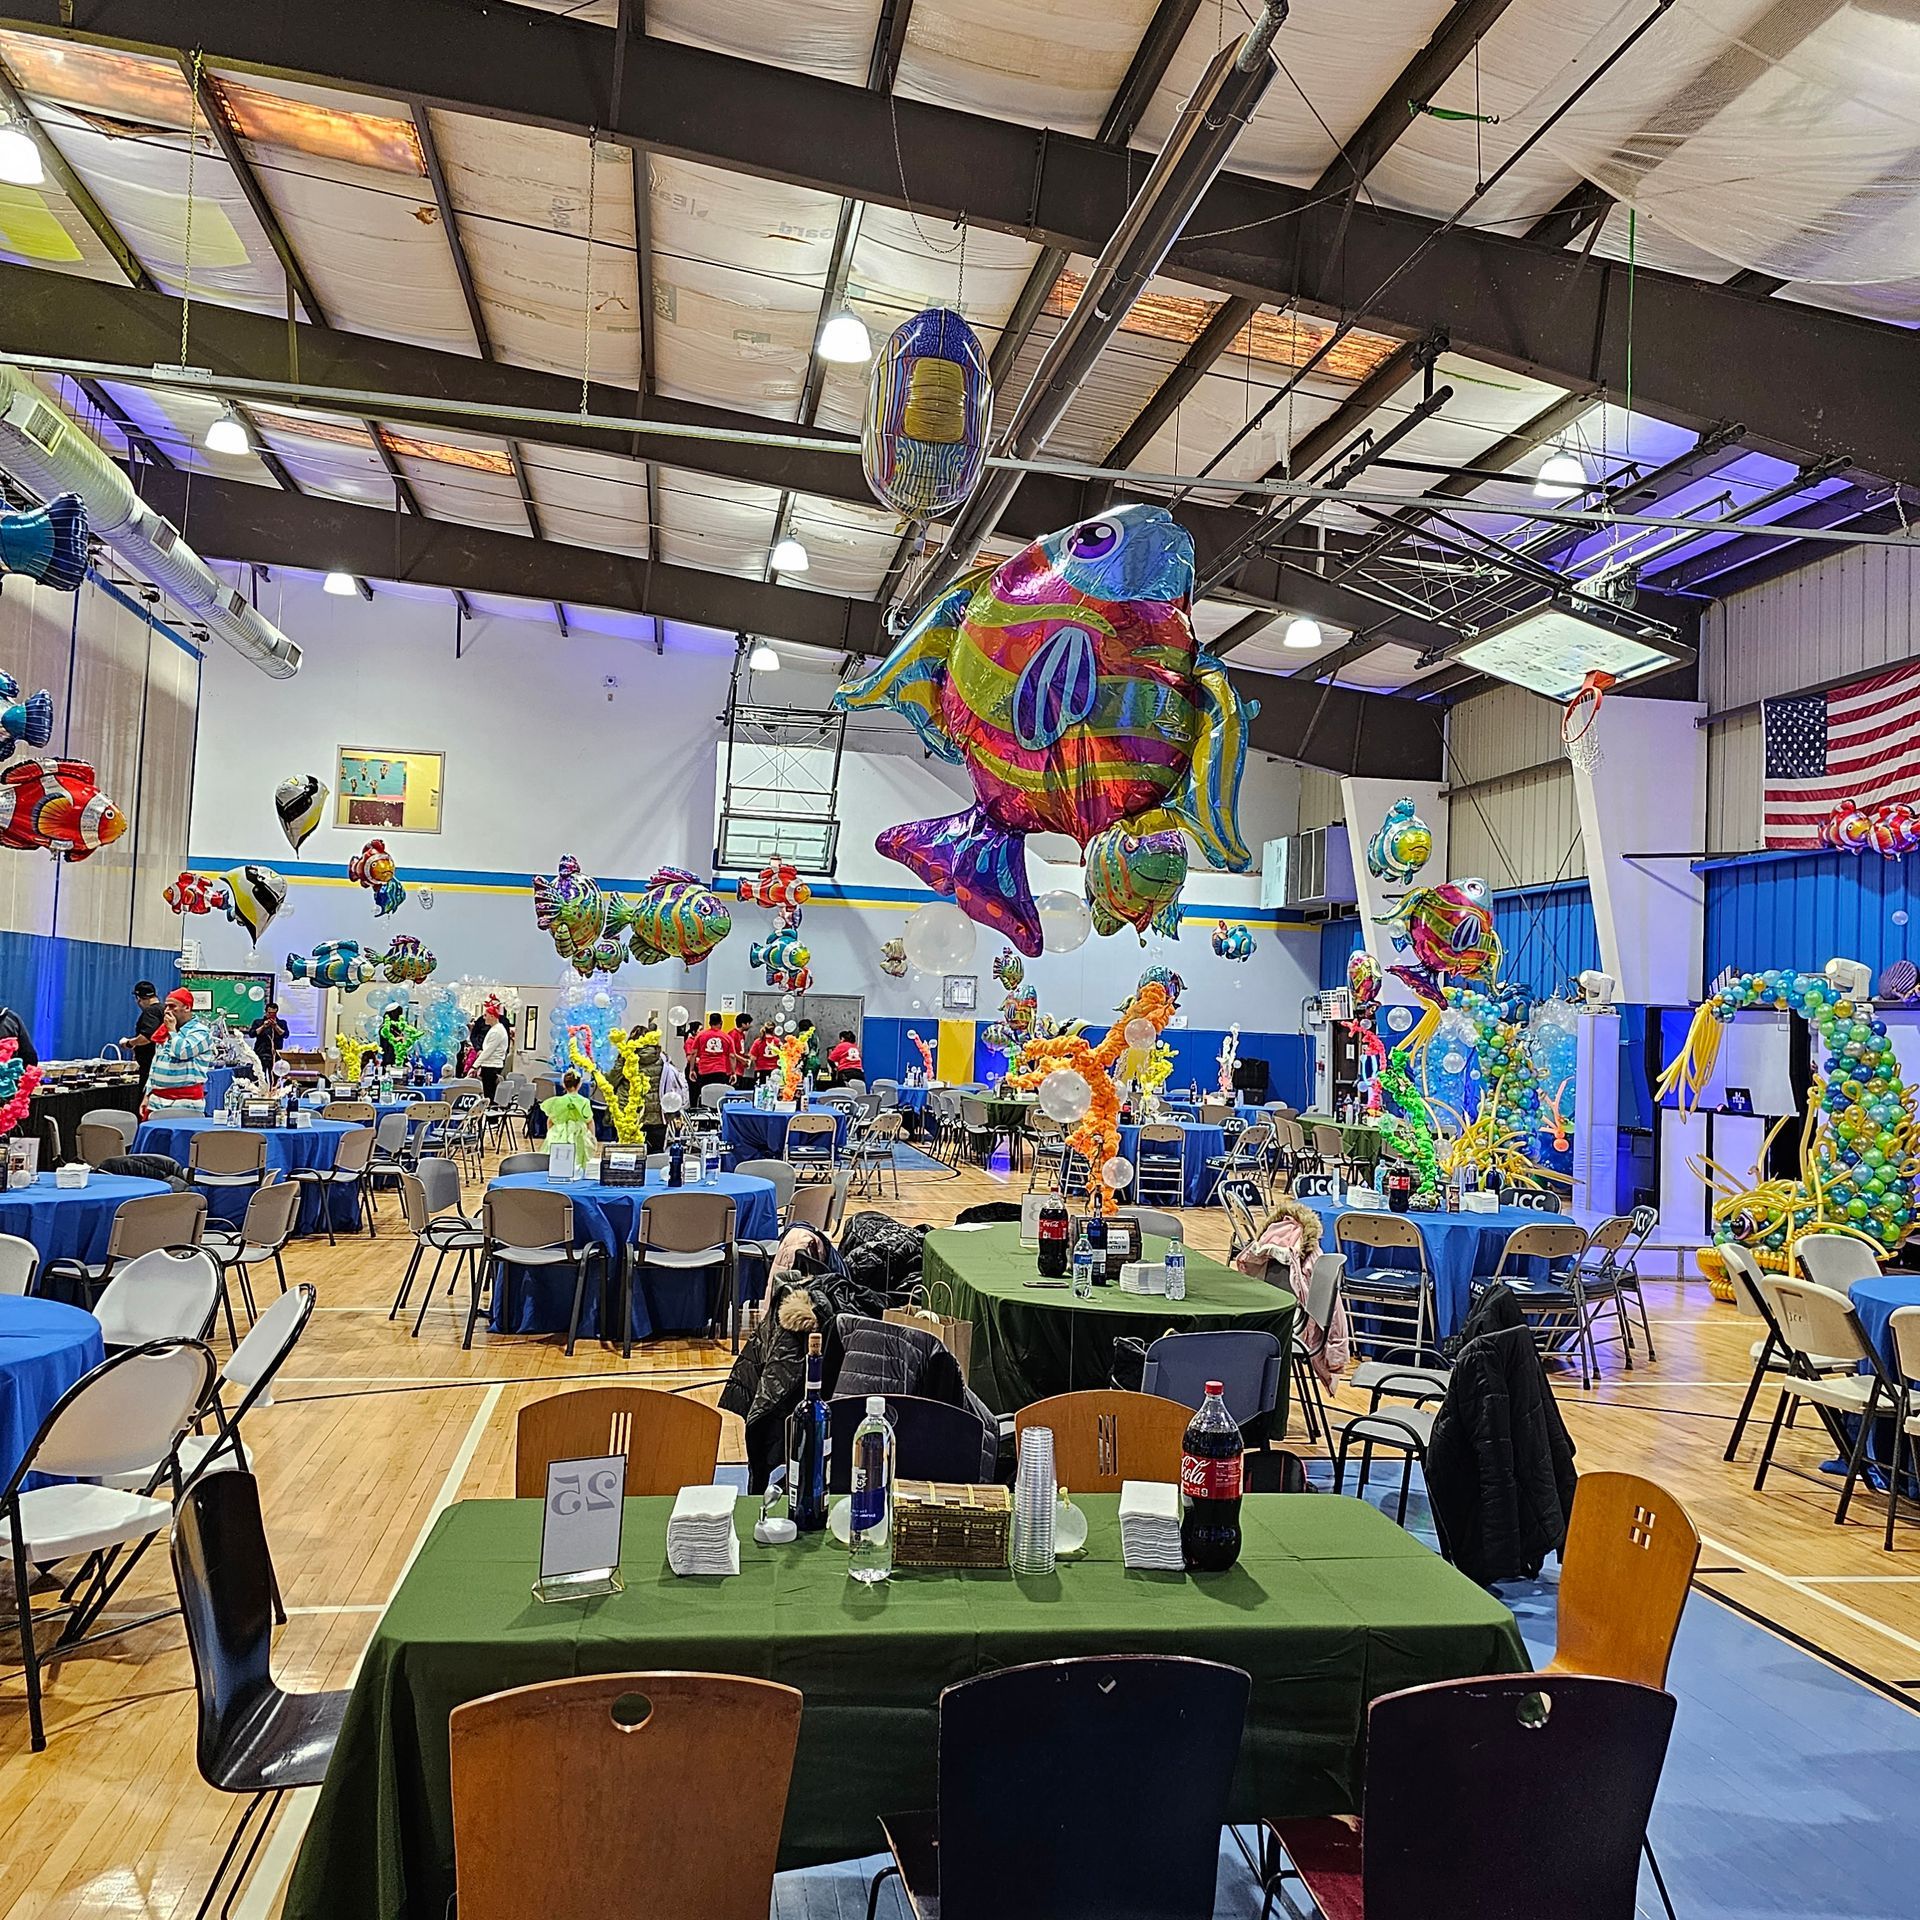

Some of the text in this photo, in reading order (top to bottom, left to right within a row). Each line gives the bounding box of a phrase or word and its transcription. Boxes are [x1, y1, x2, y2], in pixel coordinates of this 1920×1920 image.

[458, 1096, 475, 1107] JCC
[833, 1102, 851, 1113] JCC
[1224, 1120, 1241, 1131] JCC
[1508, 1192, 1546, 1211] JCC
[1633, 1210, 1649, 1232] JCC
